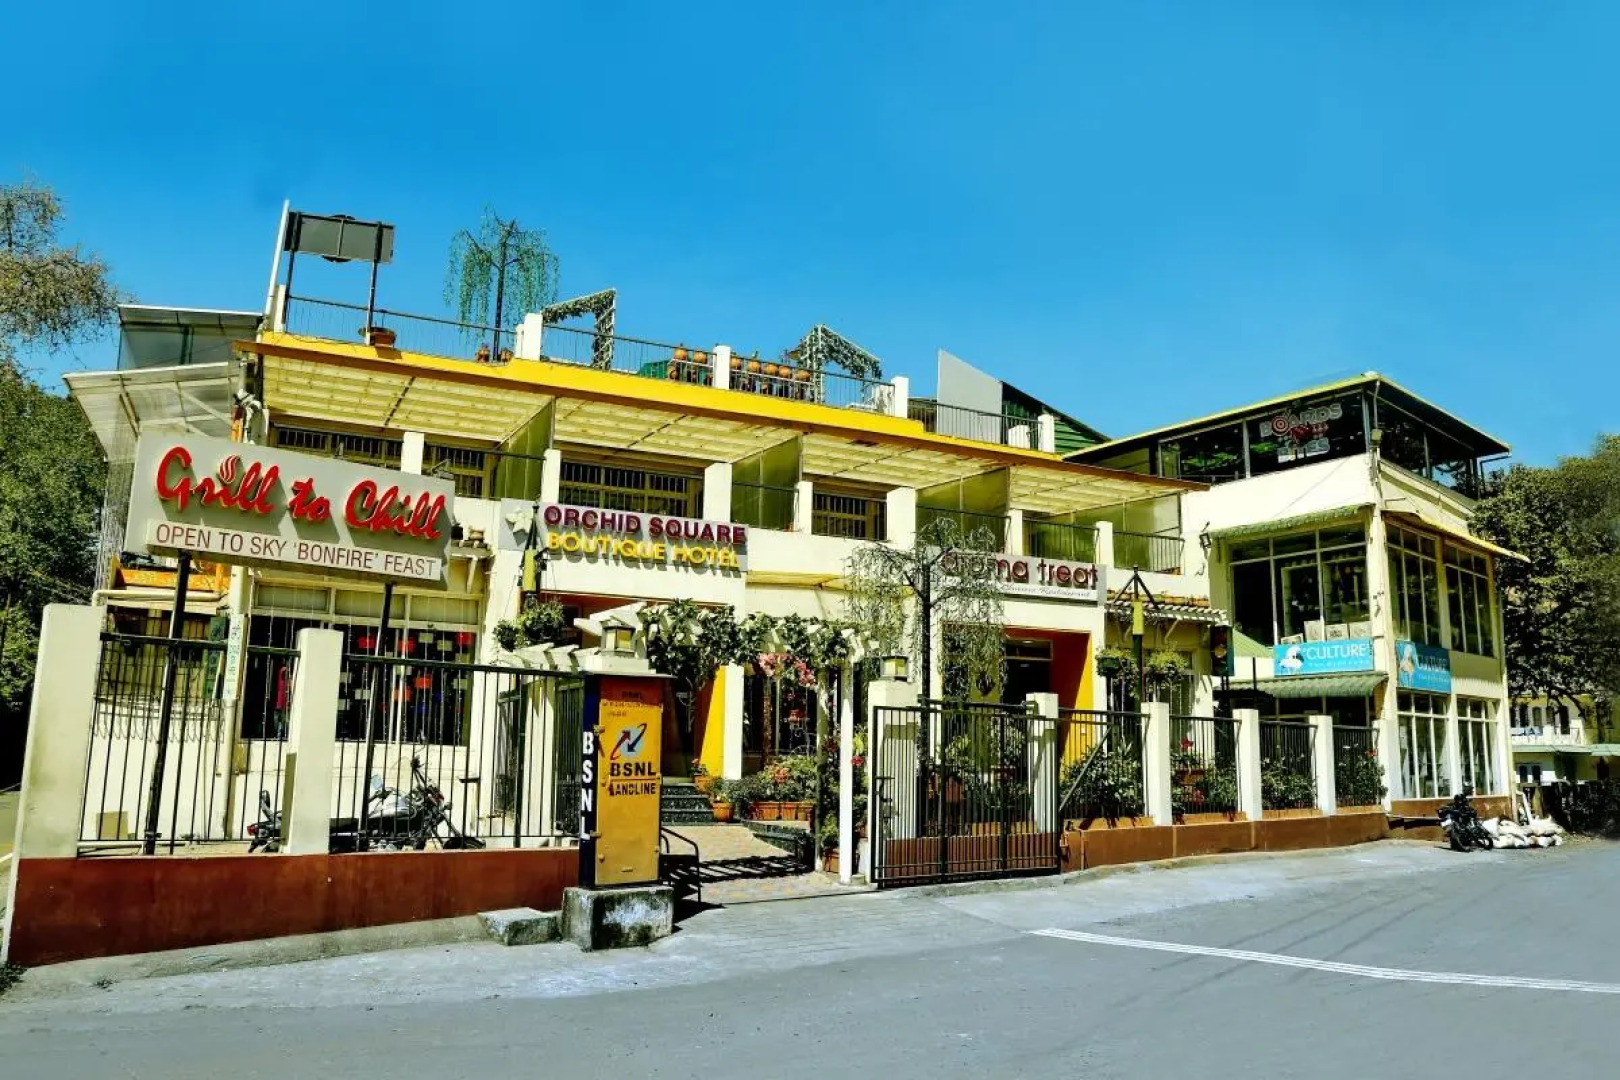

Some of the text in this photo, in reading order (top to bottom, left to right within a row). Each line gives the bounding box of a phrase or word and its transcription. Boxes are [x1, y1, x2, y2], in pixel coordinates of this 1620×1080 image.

[156, 447, 446, 540] Grill to Chill
[544, 505, 746, 545] ORCHID SQUARE
[156, 523, 211, 549] OPEN
[219, 531, 244, 552] TO
[250, 535, 287, 557] SKY
[384, 554, 437, 577] FEAST
[548, 532, 740, 568] BOUTIQUE HOTEL
[1037, 558, 1098, 586] treat
[581, 731, 594, 840] BSNL
[610, 762, 657, 776] BSNL
